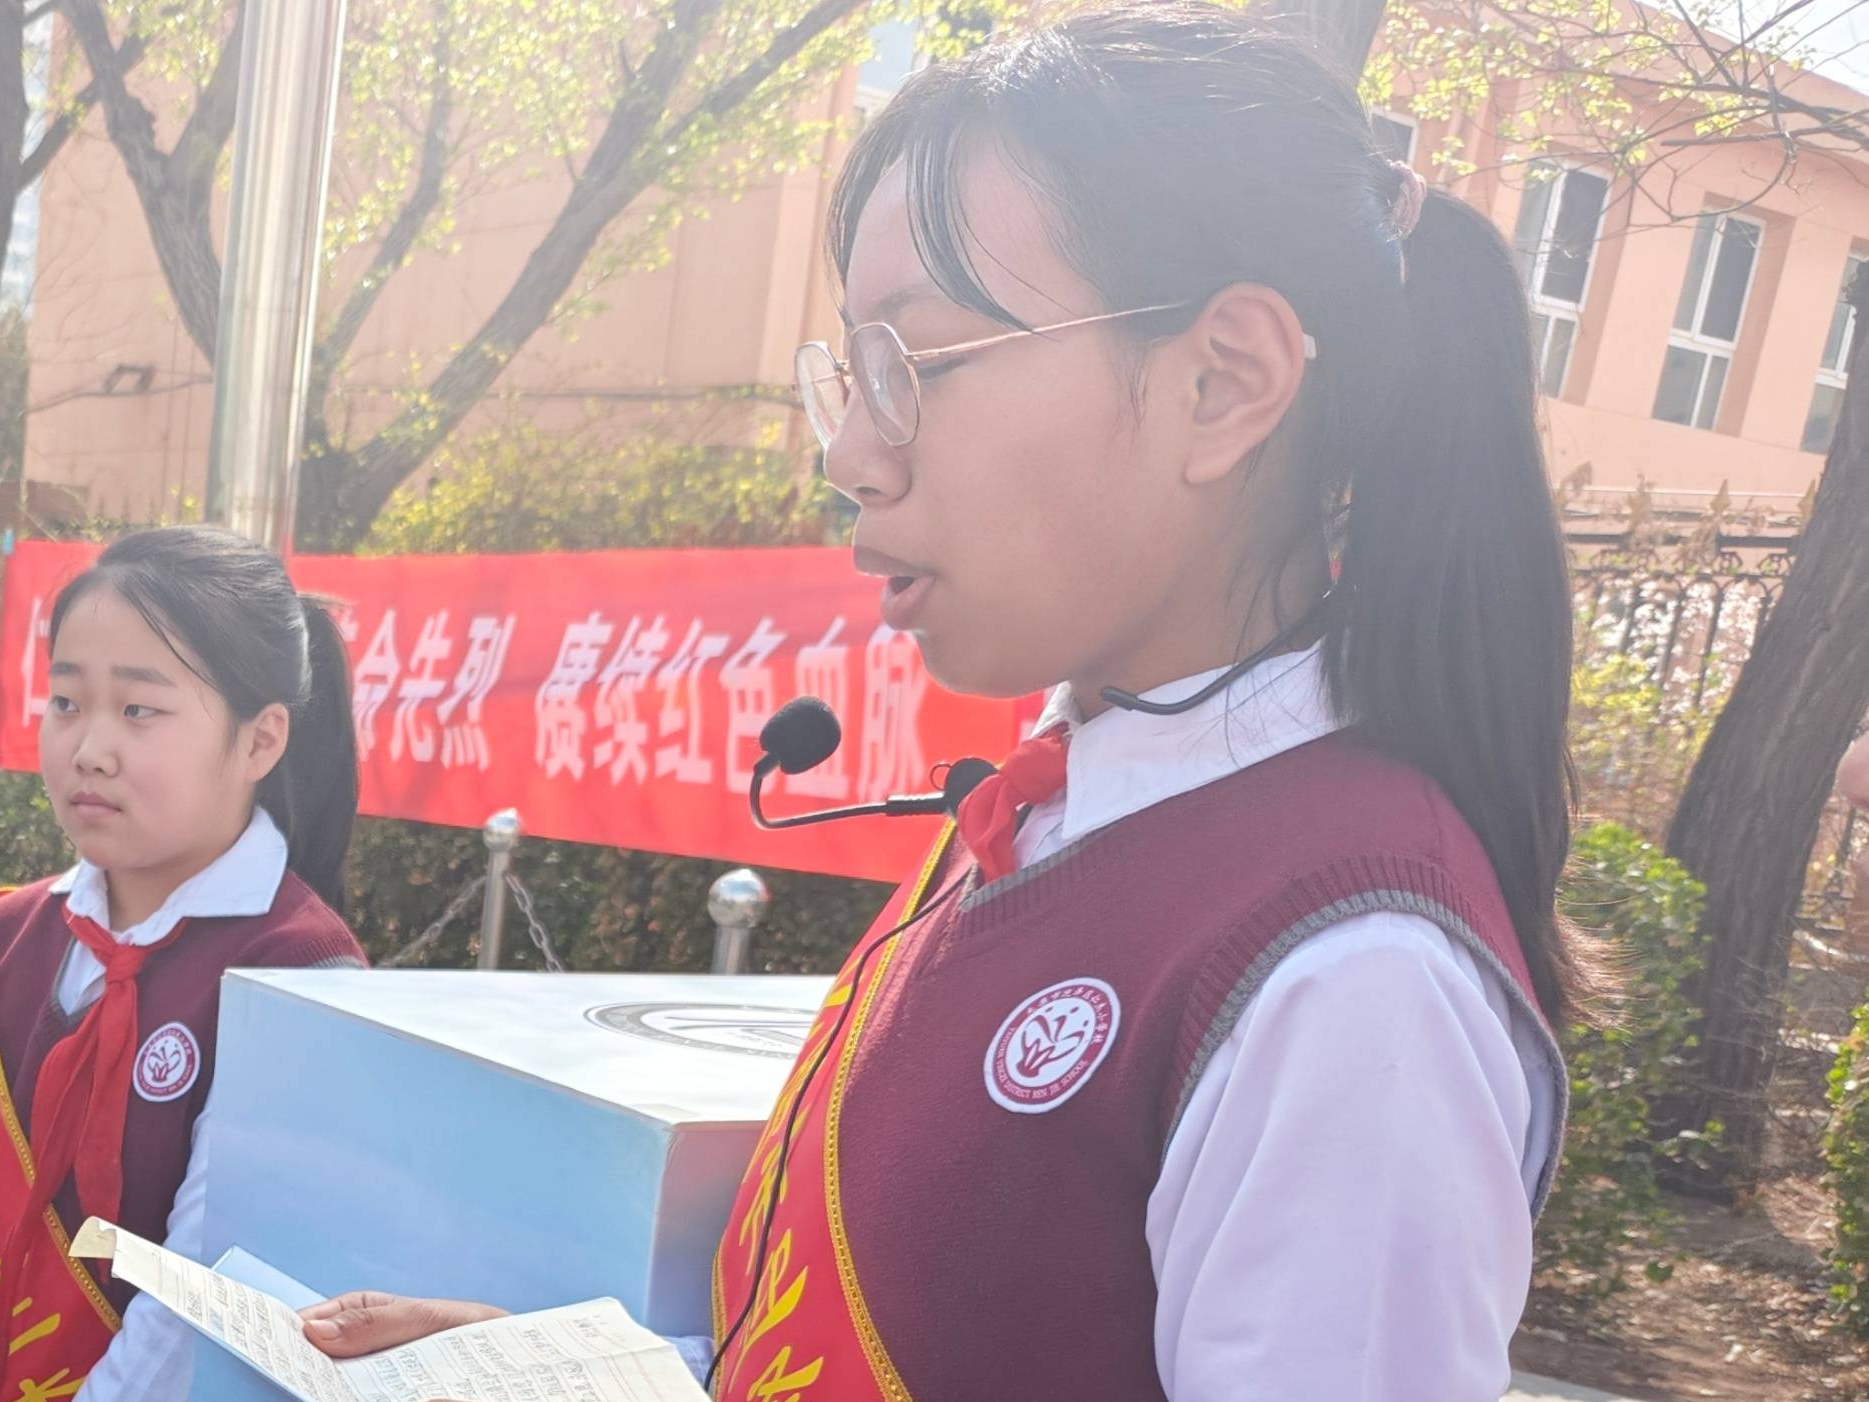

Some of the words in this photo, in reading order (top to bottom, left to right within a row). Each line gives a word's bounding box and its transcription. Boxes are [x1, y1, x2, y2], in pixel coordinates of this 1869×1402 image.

[340, 606, 517, 774] 命先烈
[534, 610, 930, 802] 赓续红色血脉
